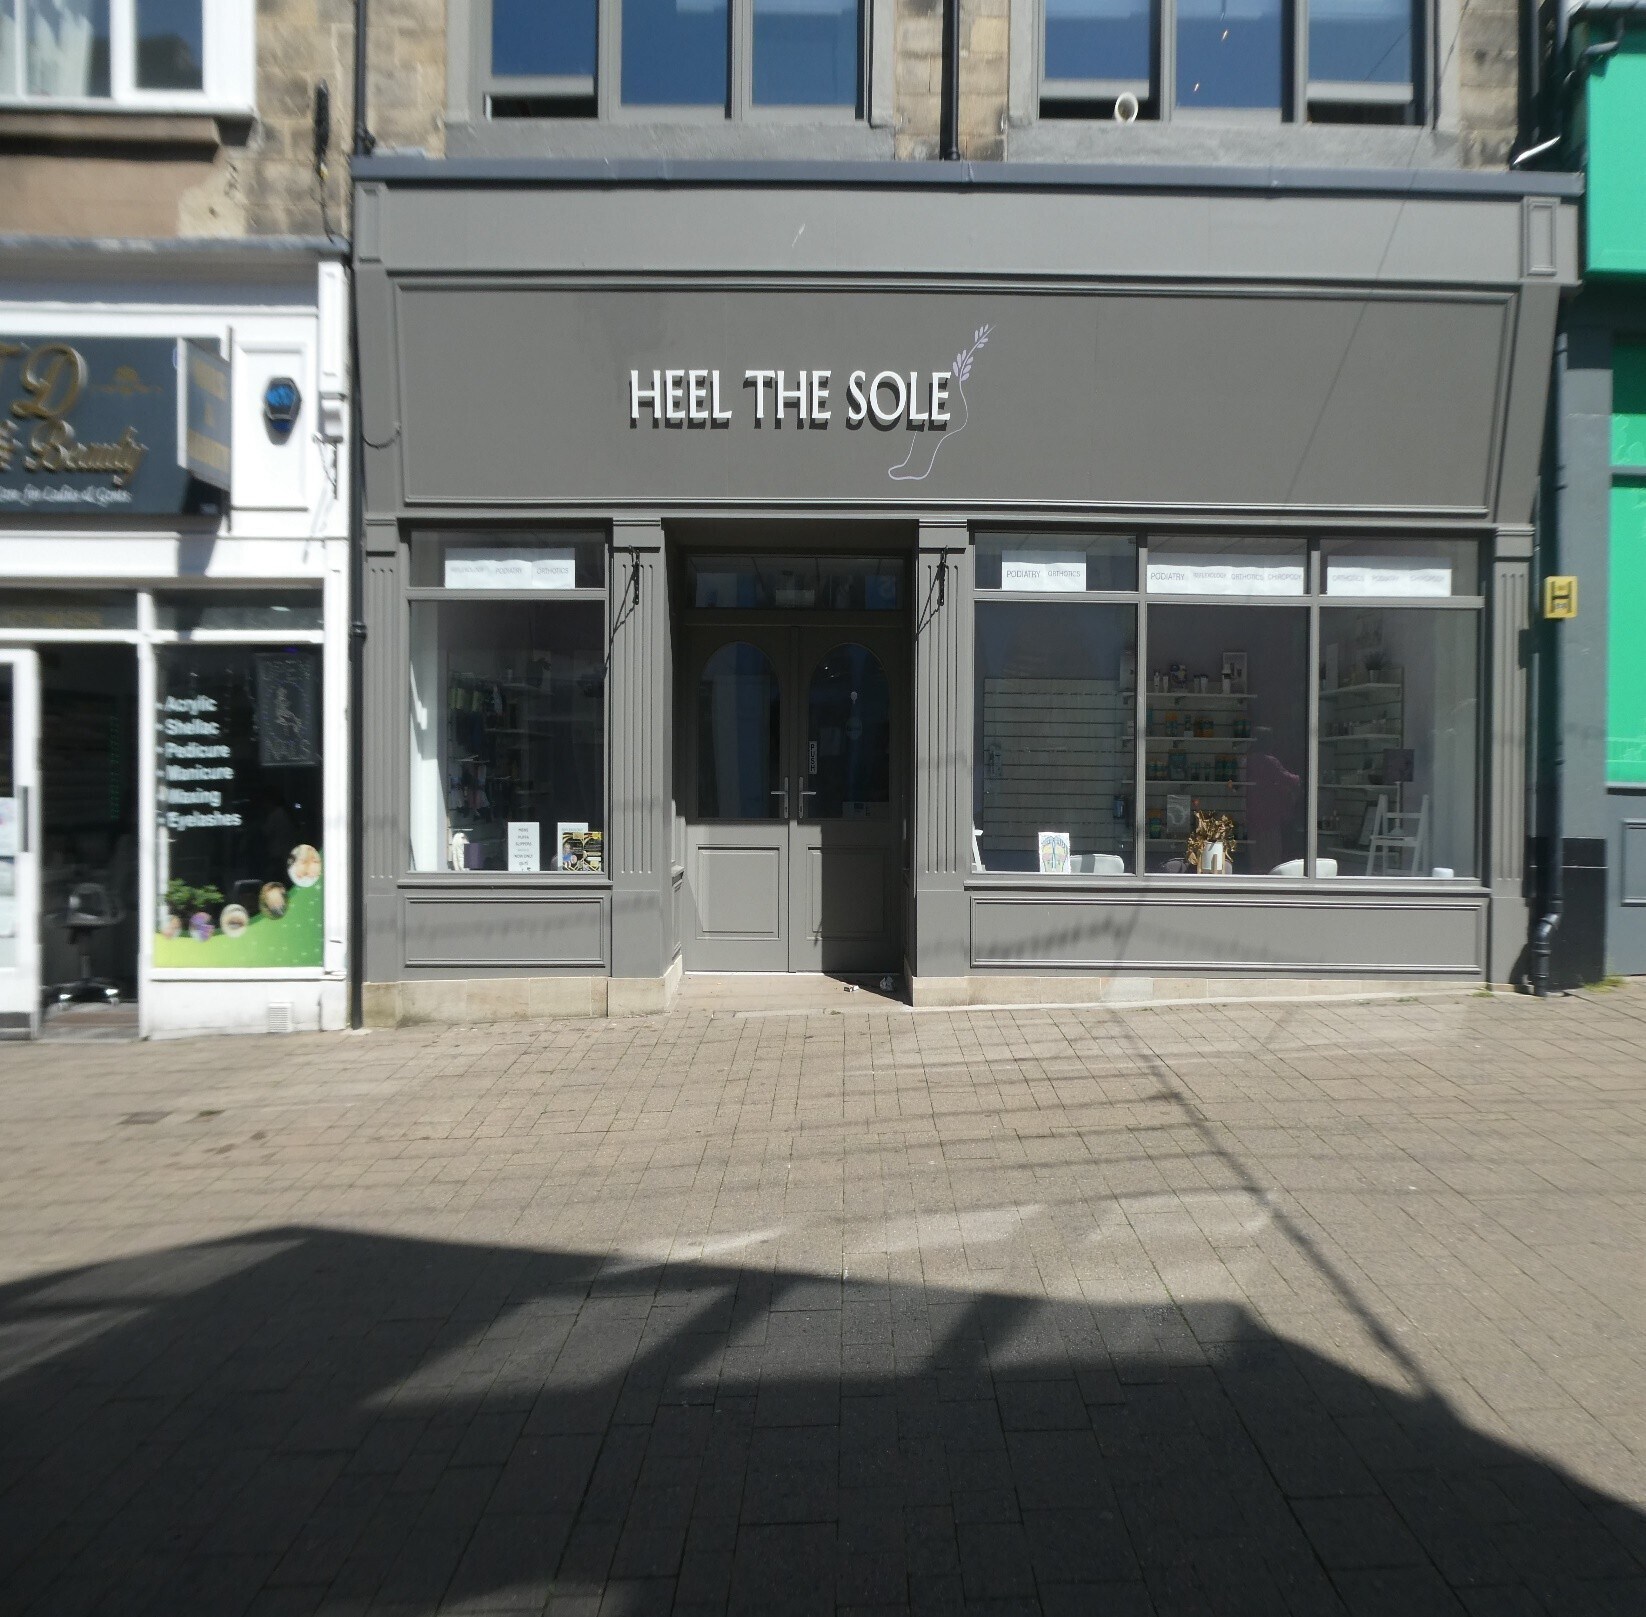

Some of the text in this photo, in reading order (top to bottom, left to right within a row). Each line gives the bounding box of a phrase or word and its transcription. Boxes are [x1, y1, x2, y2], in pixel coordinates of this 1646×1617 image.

[630, 369, 952, 421] HEEL THE SOLE
[1006, 570, 1081, 578] PODIATRY ORTHOTICS
[1150, 572, 1185, 581] PODIATRY
[1230, 573, 1264, 581] ORTHOTICS
[165, 718, 221, 736] Shellac
[165, 742, 231, 759] Pedicure
[165, 764, 235, 781] Manicure
[166, 810, 243, 831] Eyelashes
